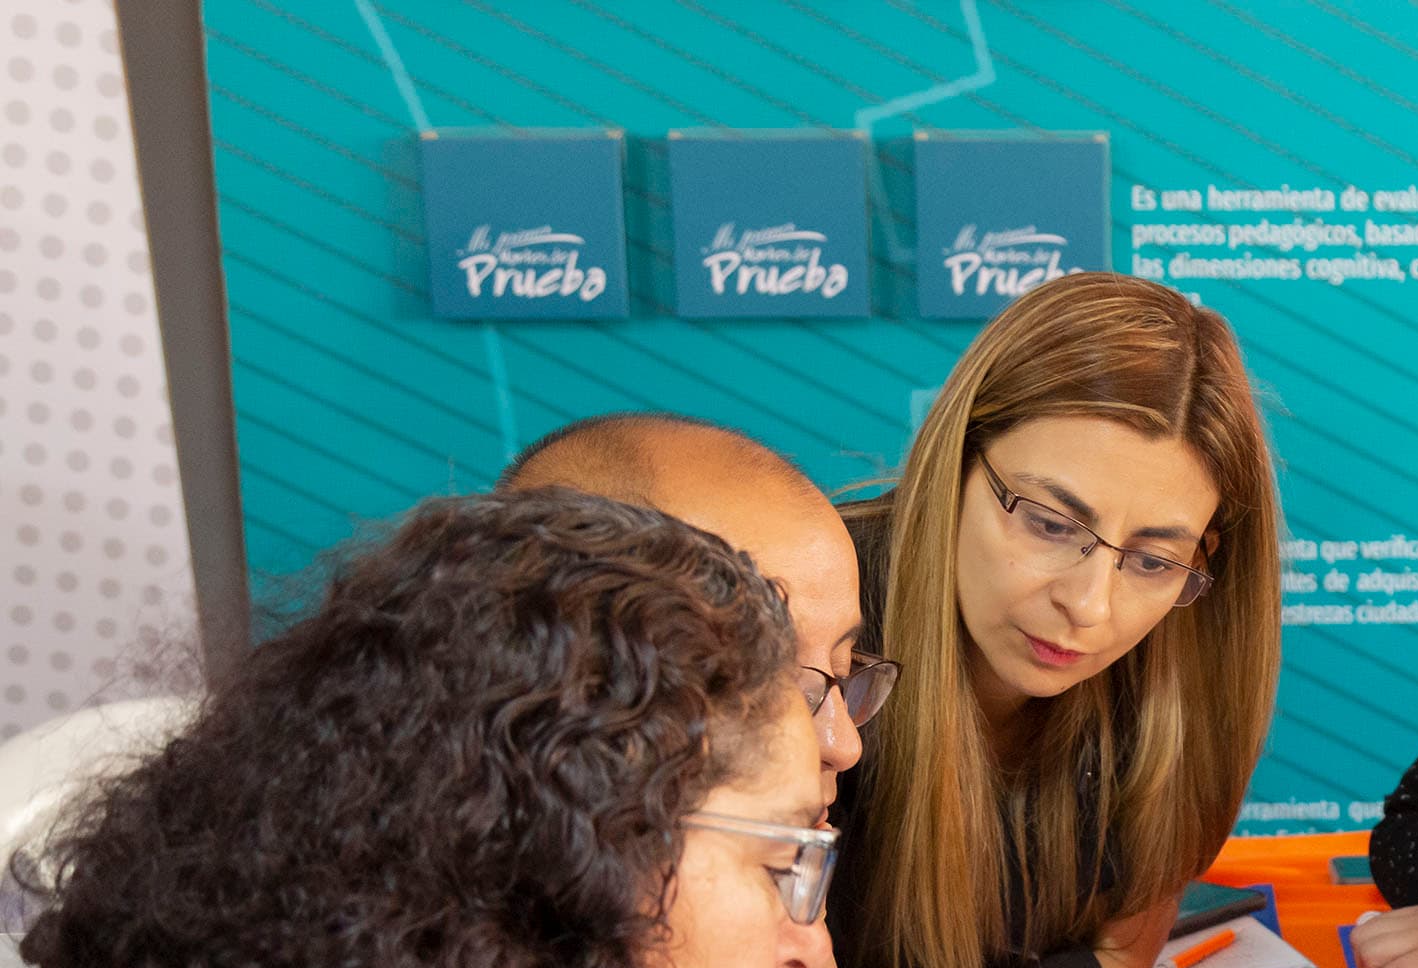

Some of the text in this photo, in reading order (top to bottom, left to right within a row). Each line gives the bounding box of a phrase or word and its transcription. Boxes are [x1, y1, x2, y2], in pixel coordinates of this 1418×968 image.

[1132, 184, 1156, 211] Es
[1161, 189, 1202, 211] una
[1207, 184, 1335, 211] herramienta
[1340, 184, 1369, 212] de
[1132, 224, 1226, 249] procesos
[1228, 218, 1362, 251] pedagógicos,
[458, 251, 606, 302] Prueba
[703, 247, 849, 299] Prueba
[1132, 253, 1164, 279] las
[1168, 252, 1302, 279] dimensiones
[1305, 252, 1405, 285] cognitiva,
[1321, 540, 1358, 563] que
[1324, 568, 1350, 592] de
